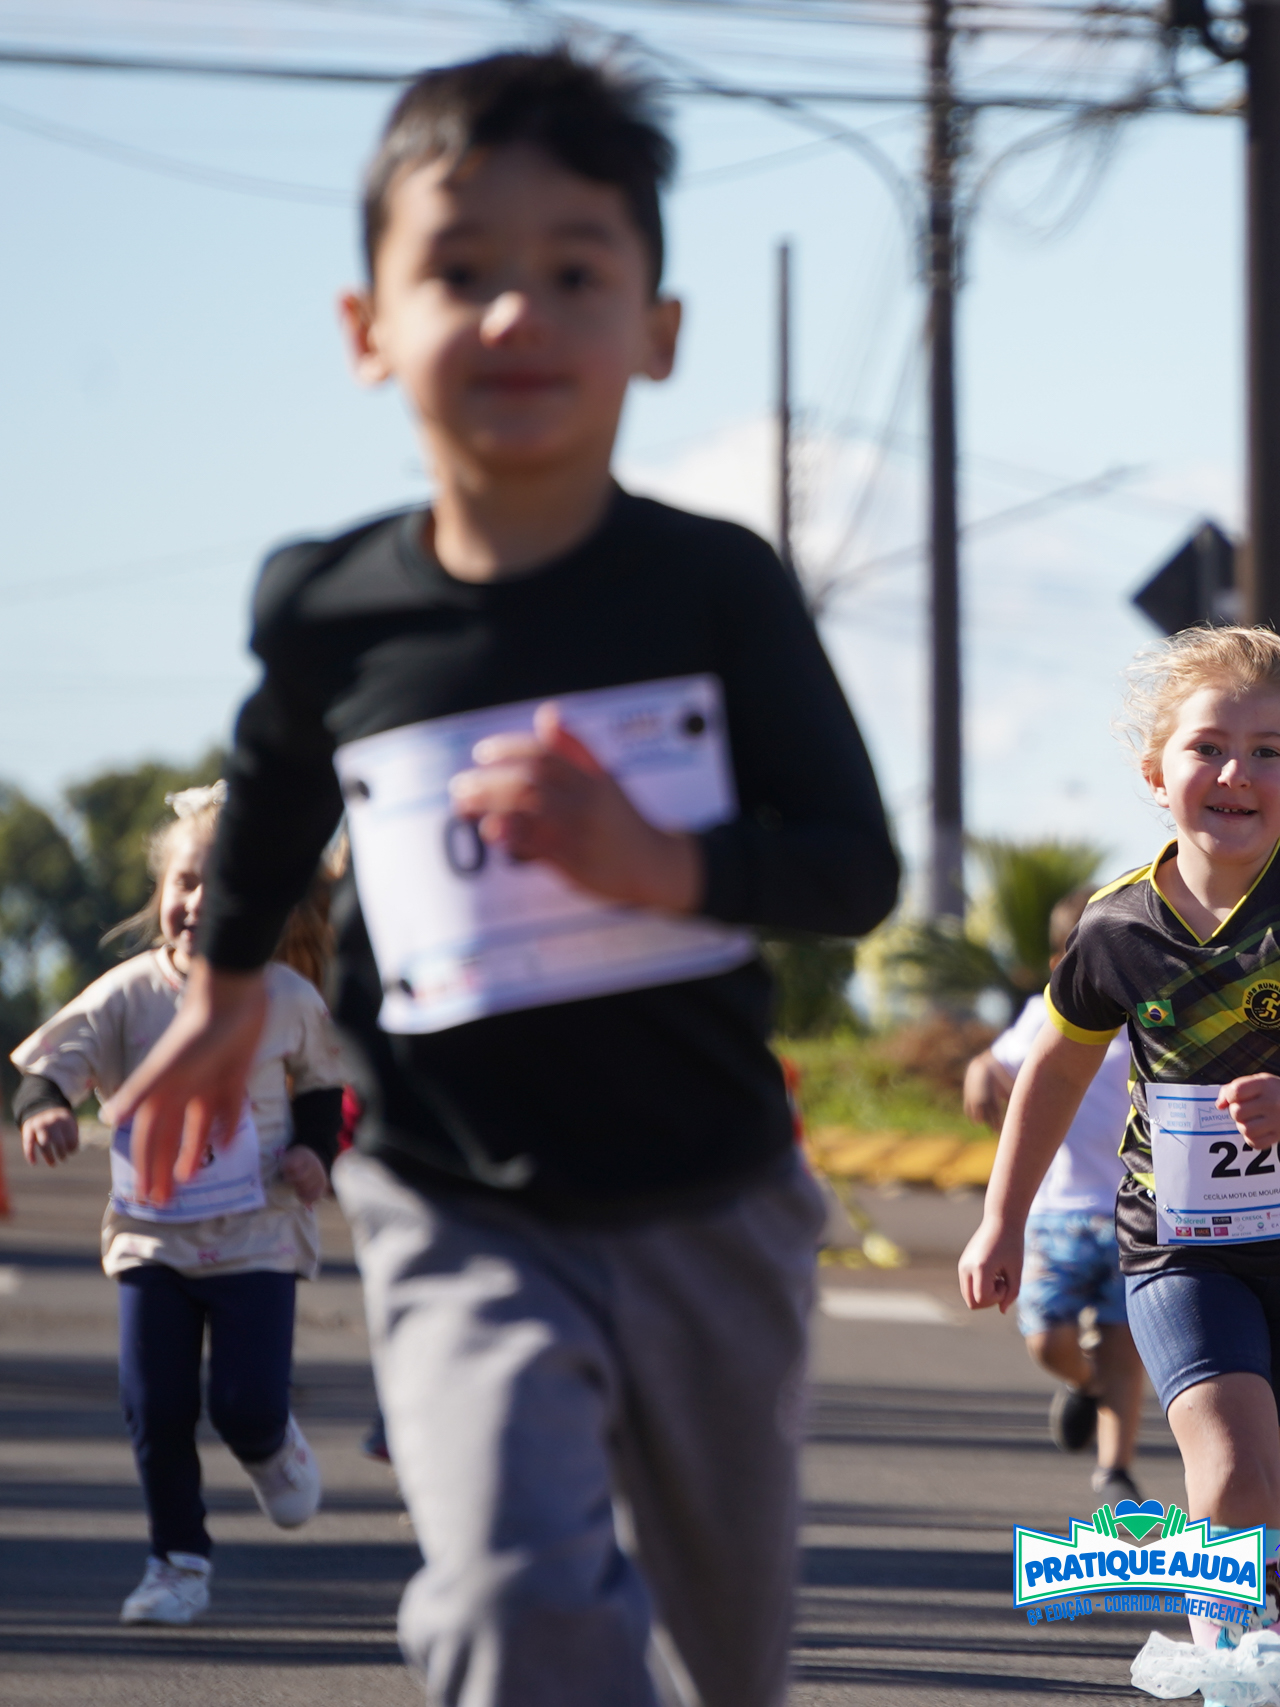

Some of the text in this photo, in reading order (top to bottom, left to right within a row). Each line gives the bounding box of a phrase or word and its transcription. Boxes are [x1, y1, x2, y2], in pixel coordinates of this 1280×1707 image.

[1201, 1114, 1230, 1123] PRATIQUE
[1203, 1193, 1228, 1201] CECÍLIA
[1228, 1191, 1248, 1200] MOTA
[1248, 1189, 1258, 1198] DE
[1241, 1214, 1264, 1222] CRESOL
